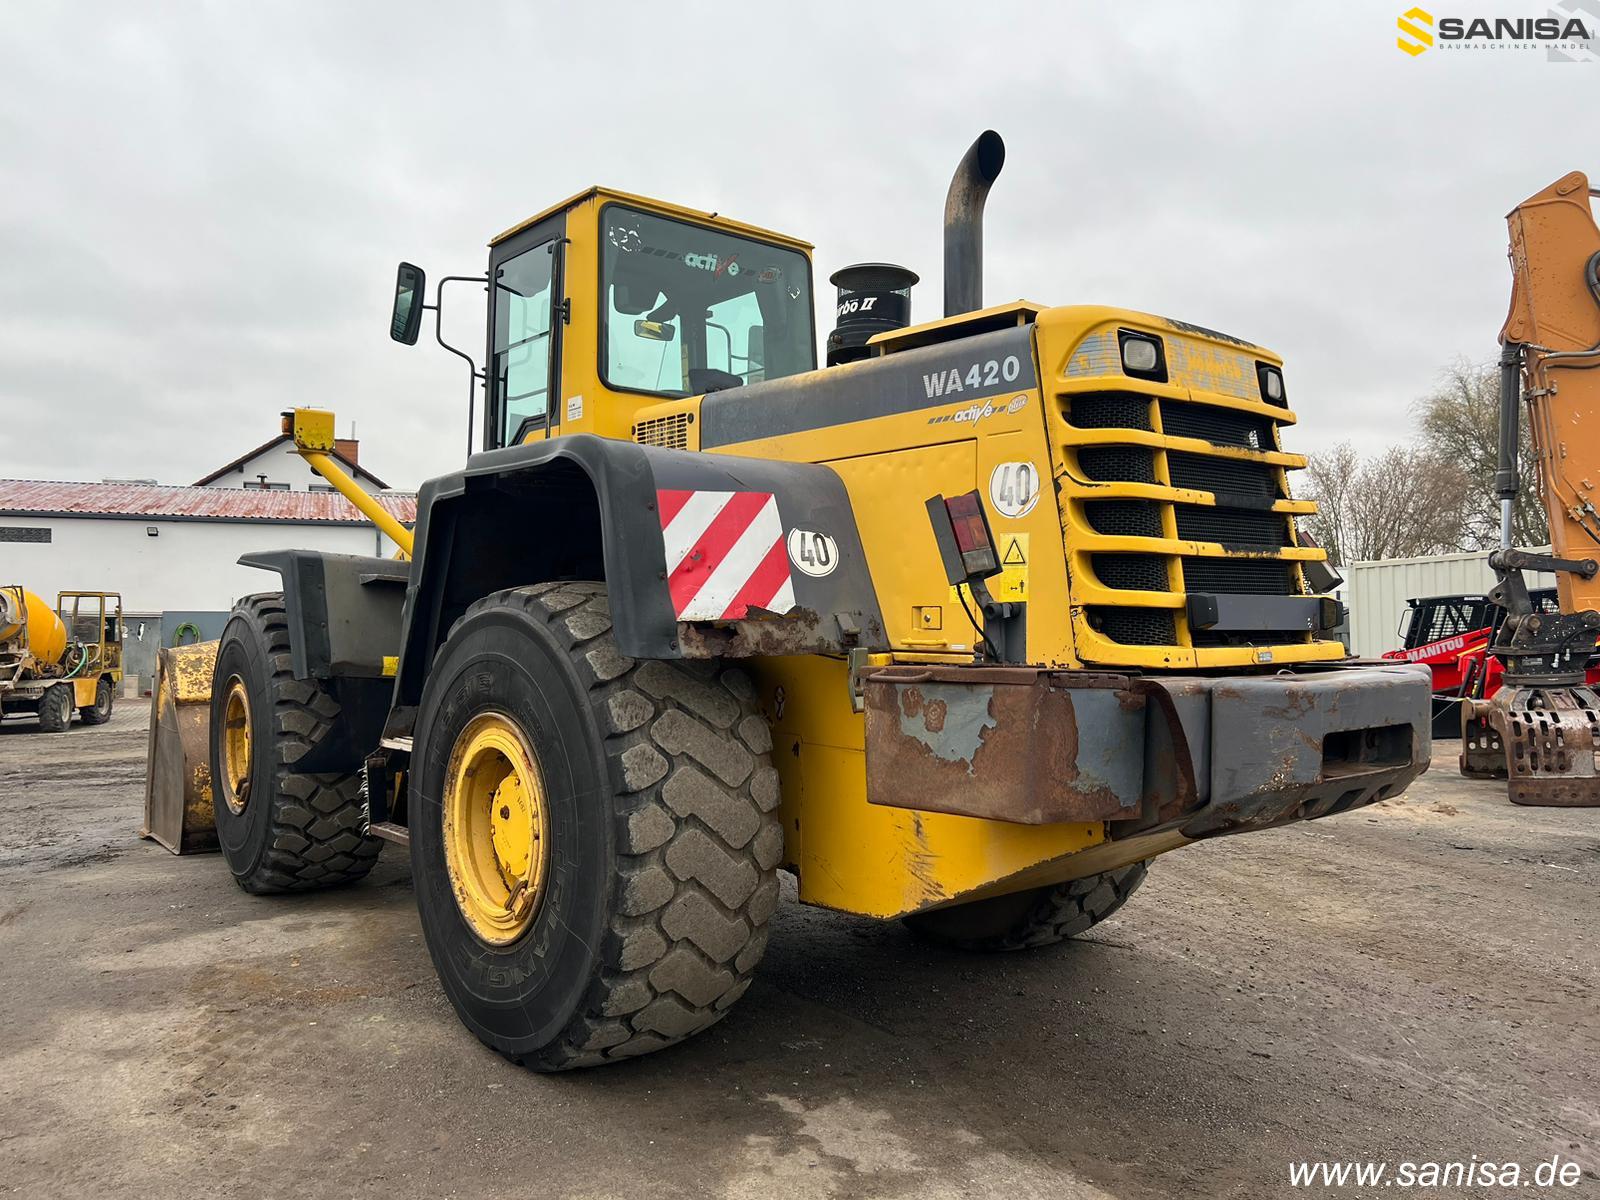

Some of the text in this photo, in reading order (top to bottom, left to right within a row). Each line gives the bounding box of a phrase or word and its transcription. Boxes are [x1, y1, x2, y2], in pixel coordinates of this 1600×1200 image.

[859, 297, 877, 311] II
[922, 355, 1020, 398] WA420
[954, 399, 993, 425] active
[999, 464, 1030, 506] 40
[801, 533, 830, 566] 40
[1406, 637, 1464, 662] MANITOU
